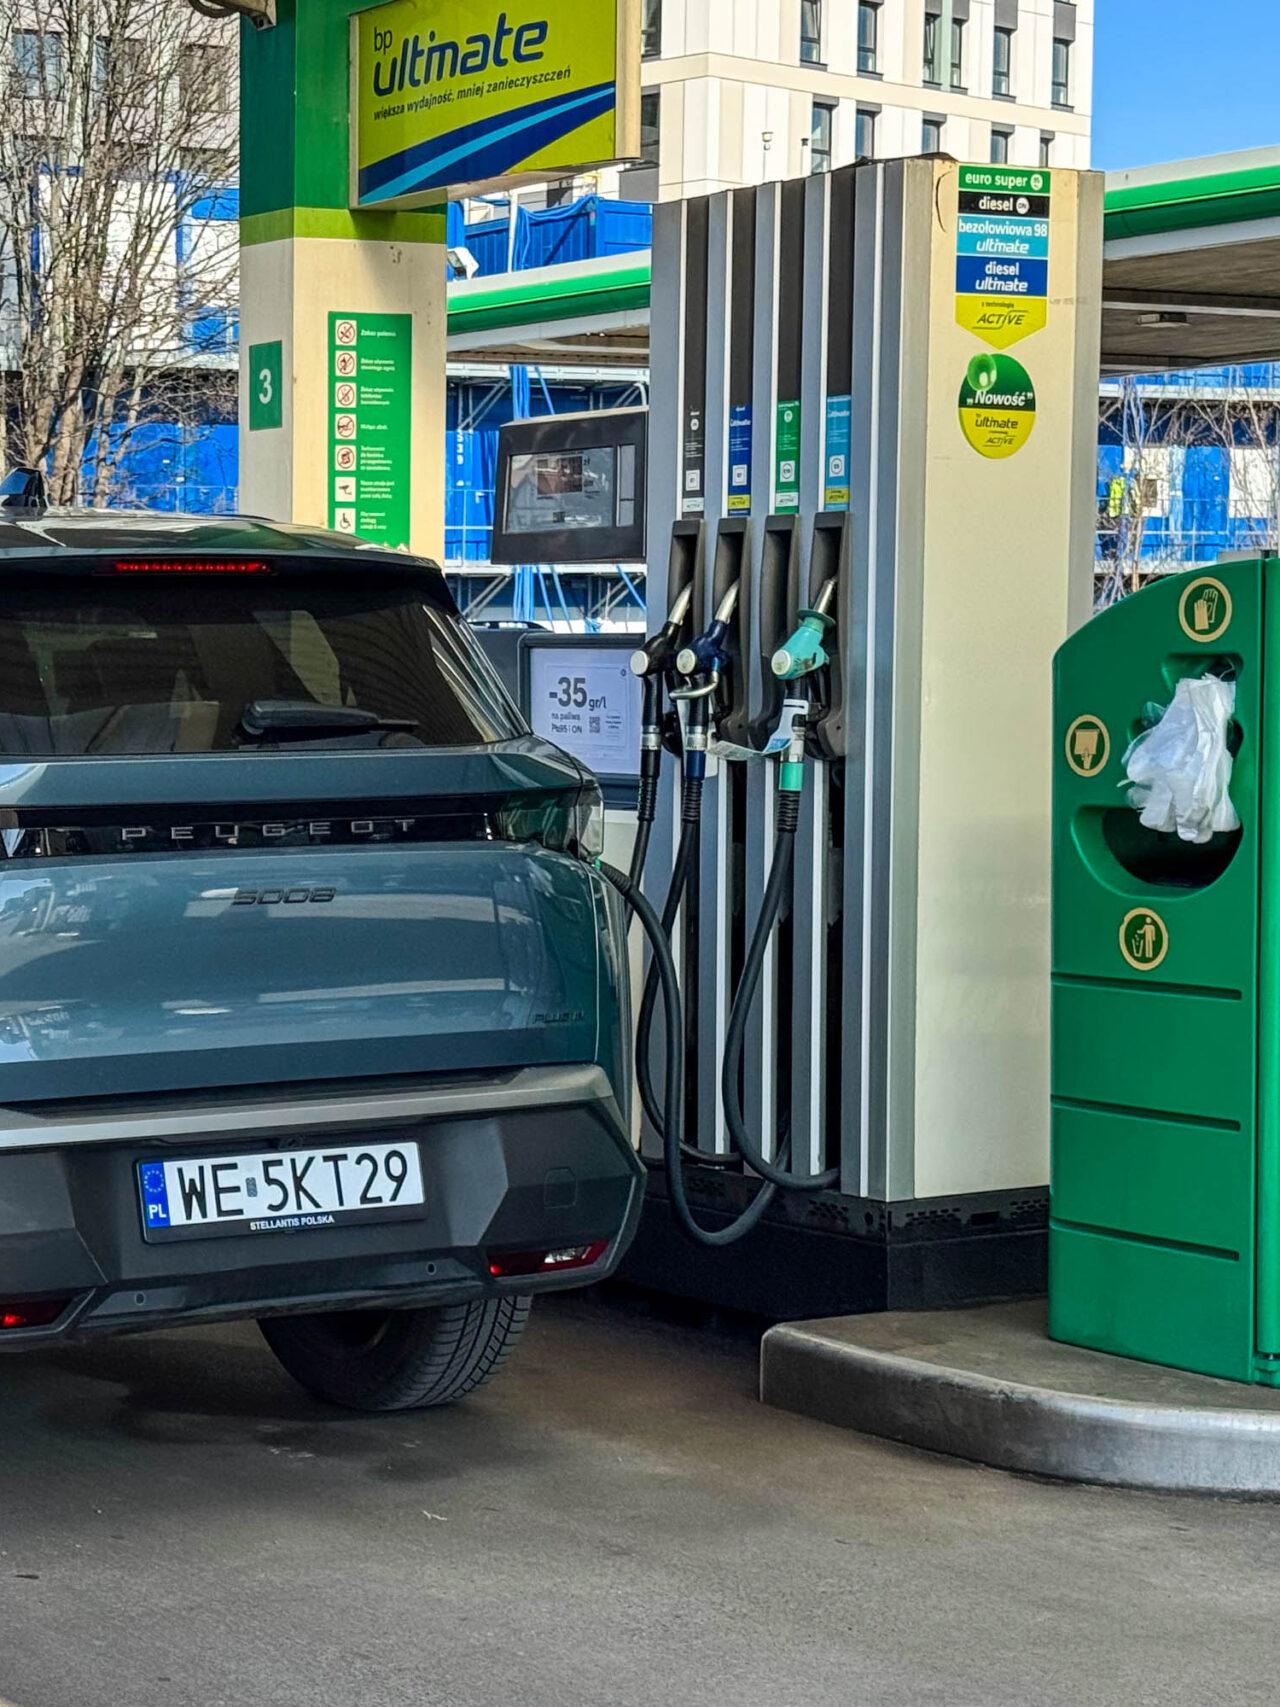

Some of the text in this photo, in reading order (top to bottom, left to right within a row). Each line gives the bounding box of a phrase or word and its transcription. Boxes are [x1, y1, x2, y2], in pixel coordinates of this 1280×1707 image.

[374, 26, 393, 55] bp
[373, 12, 549, 97] ultimate
[374, 65, 571, 121] większa wydajność, mniej zanieczyszczeń
[965, 173, 992, 185] euro
[995, 175, 1028, 189] super
[978, 196, 1013, 211] diesel
[1033, 223, 1048, 237] 98
[976, 238, 1030, 254] ultimate
[985, 261, 1019, 275] diesel
[975, 278, 1028, 292] ultimate
[975, 311, 1027, 327] ACTIVE
[258, 368, 273, 404] 3
[975, 416, 1019, 430] ultimate
[985, 436, 1015, 446] ACTIVE
[549, 676, 587, 708] -35
[571, 725, 582, 734] ON
[122, 819, 416, 841] PEUGEOT
[232, 886, 337, 906] 5008
[177, 1149, 408, 1221] WE 5KT29
[148, 1204, 167, 1219] PL
[250, 1214, 335, 1231] STELLANTIS POLSKA
